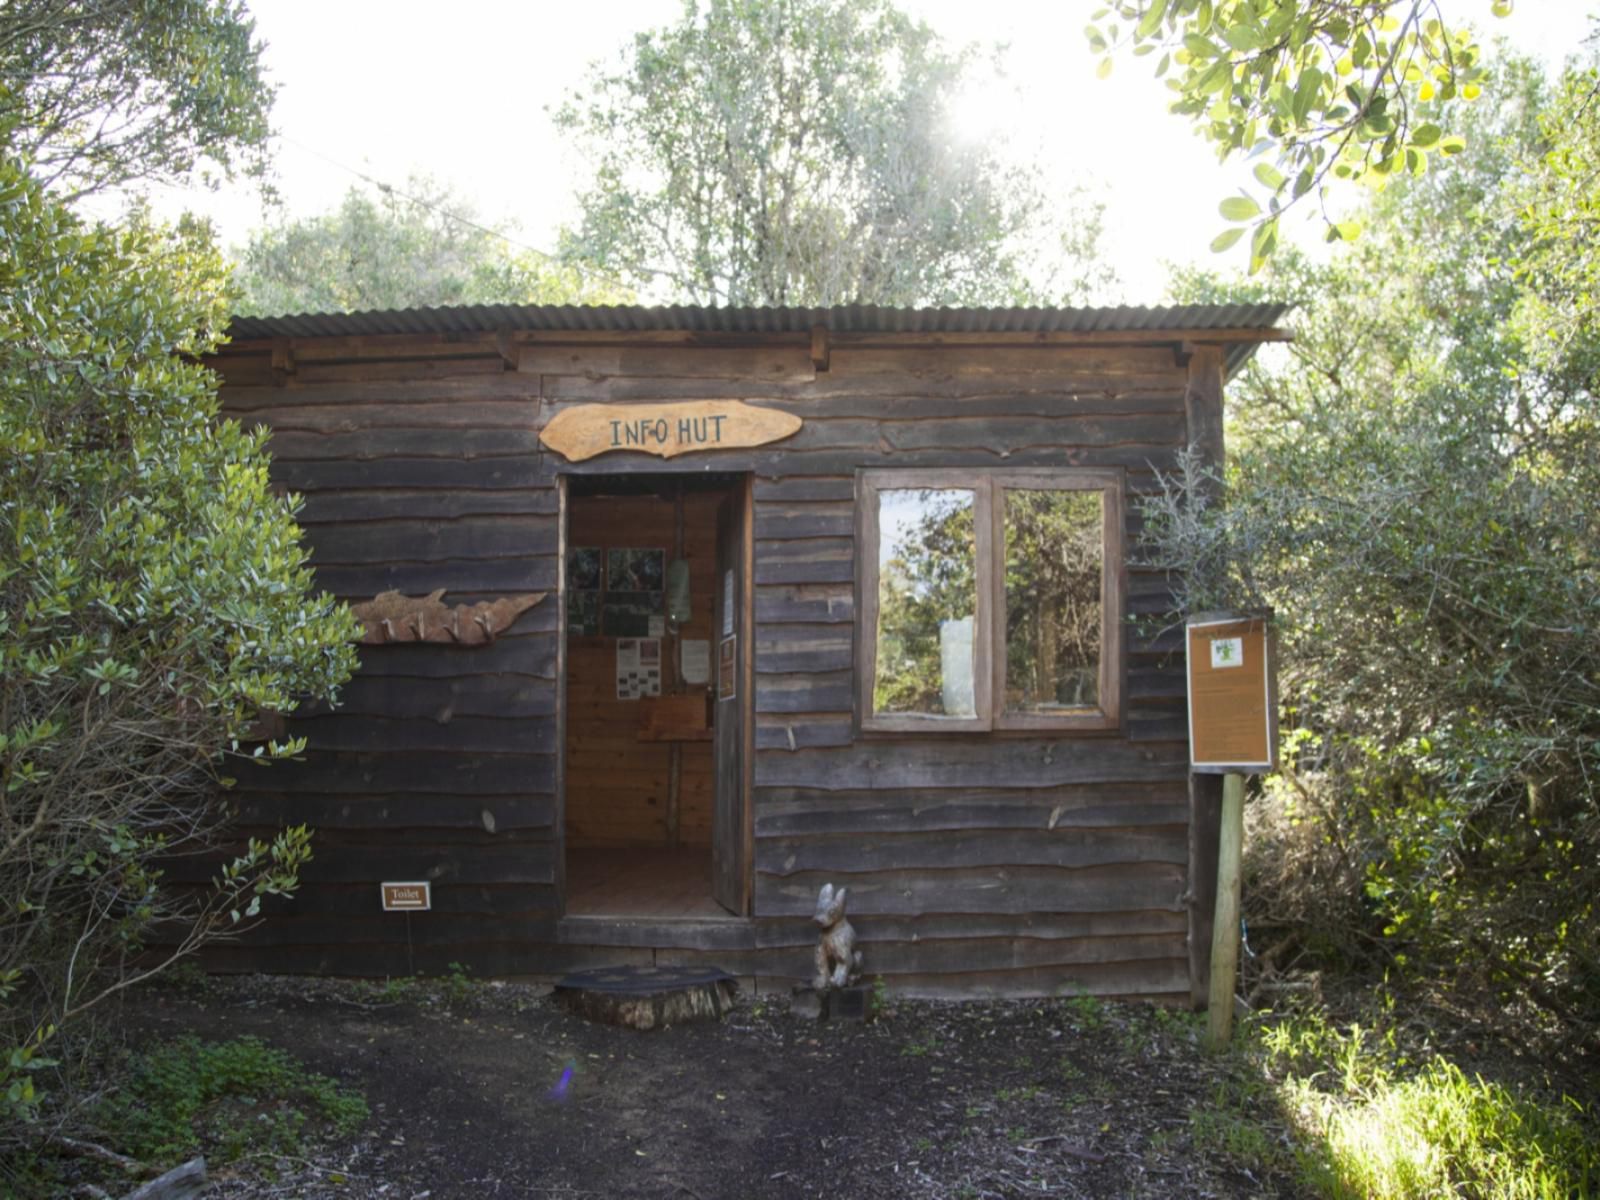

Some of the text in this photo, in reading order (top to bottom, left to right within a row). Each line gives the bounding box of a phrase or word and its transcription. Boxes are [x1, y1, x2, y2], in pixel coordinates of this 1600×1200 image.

[610, 415, 727, 446] INFO HUT
[391, 888, 419, 899] Toilet
